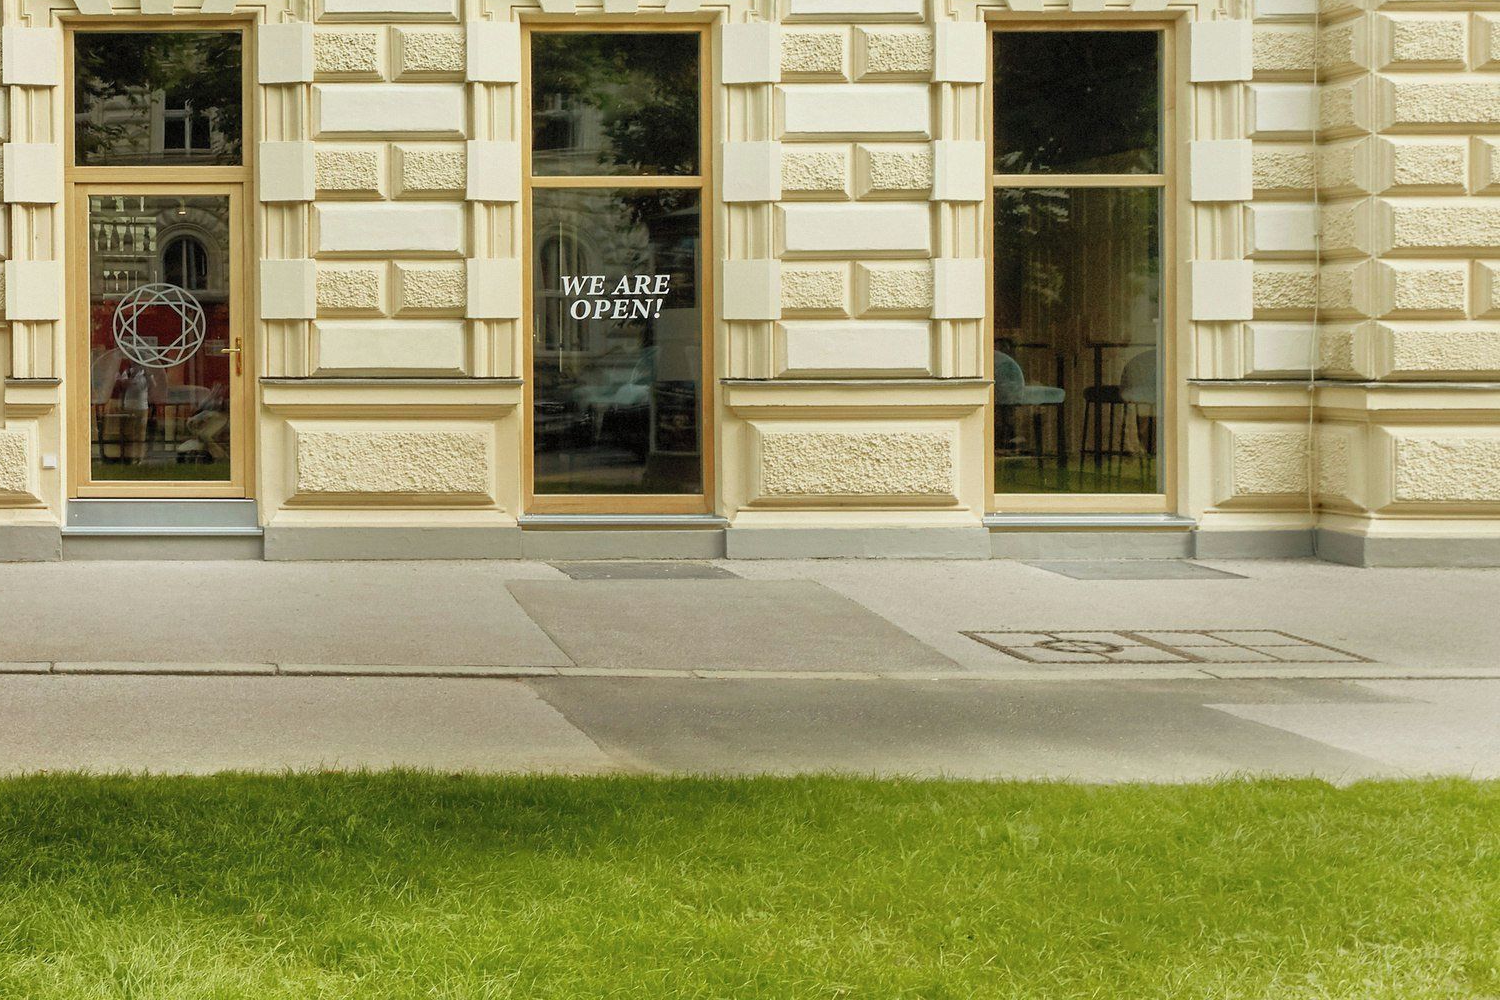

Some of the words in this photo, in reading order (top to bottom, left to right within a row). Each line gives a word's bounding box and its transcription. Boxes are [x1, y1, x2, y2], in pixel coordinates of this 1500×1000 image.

[560, 275, 606, 296] WE
[610, 274, 671, 295] ARE
[570, 298, 663, 320] OPEN!
